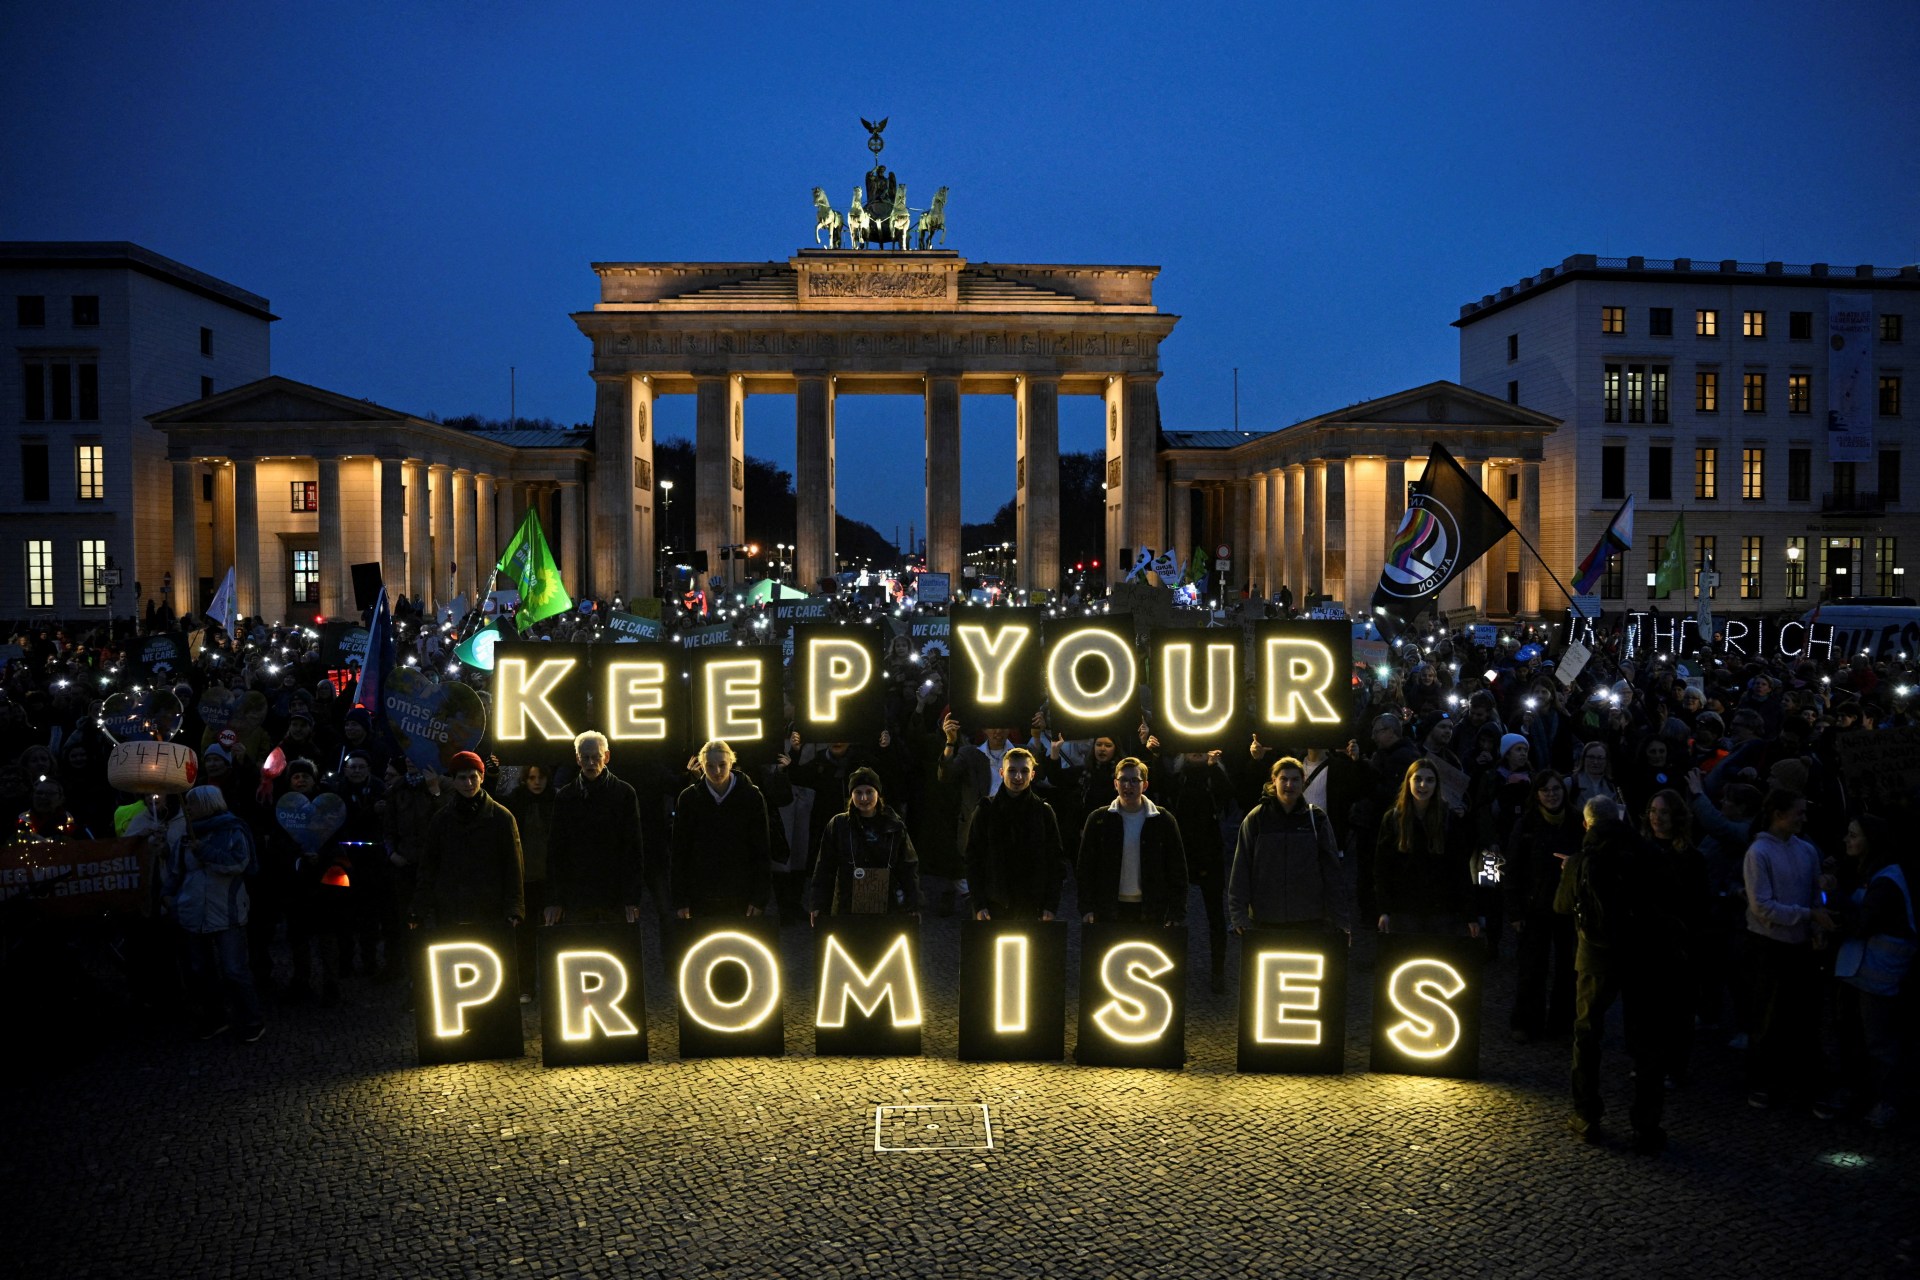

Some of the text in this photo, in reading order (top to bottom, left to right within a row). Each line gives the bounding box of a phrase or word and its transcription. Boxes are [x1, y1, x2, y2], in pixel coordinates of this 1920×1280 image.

[777, 604, 827, 619] WE CARE.
[609, 617, 656, 639] WE CARE.
[912, 623, 950, 637] WE CAR
[339, 641, 368, 654] WE CAR
[683, 629, 732, 649] WE CARE.
[1724, 618, 1835, 661] RICH
[141, 652, 154, 663] WE
[496, 625, 1341, 745] KEEP YOUR
[202, 705, 229, 717] OMAS
[386, 696, 430, 721] omas
[105, 714, 142, 726] omas
[120, 721, 158, 737] future
[429, 716, 449, 732] for
[400, 716, 449, 744] future
[279, 811, 307, 820] OMAS
[77, 855, 140, 878] FOSSIL
[54, 872, 141, 897] GERECHT
[427, 930, 1466, 1060] PROMISES
